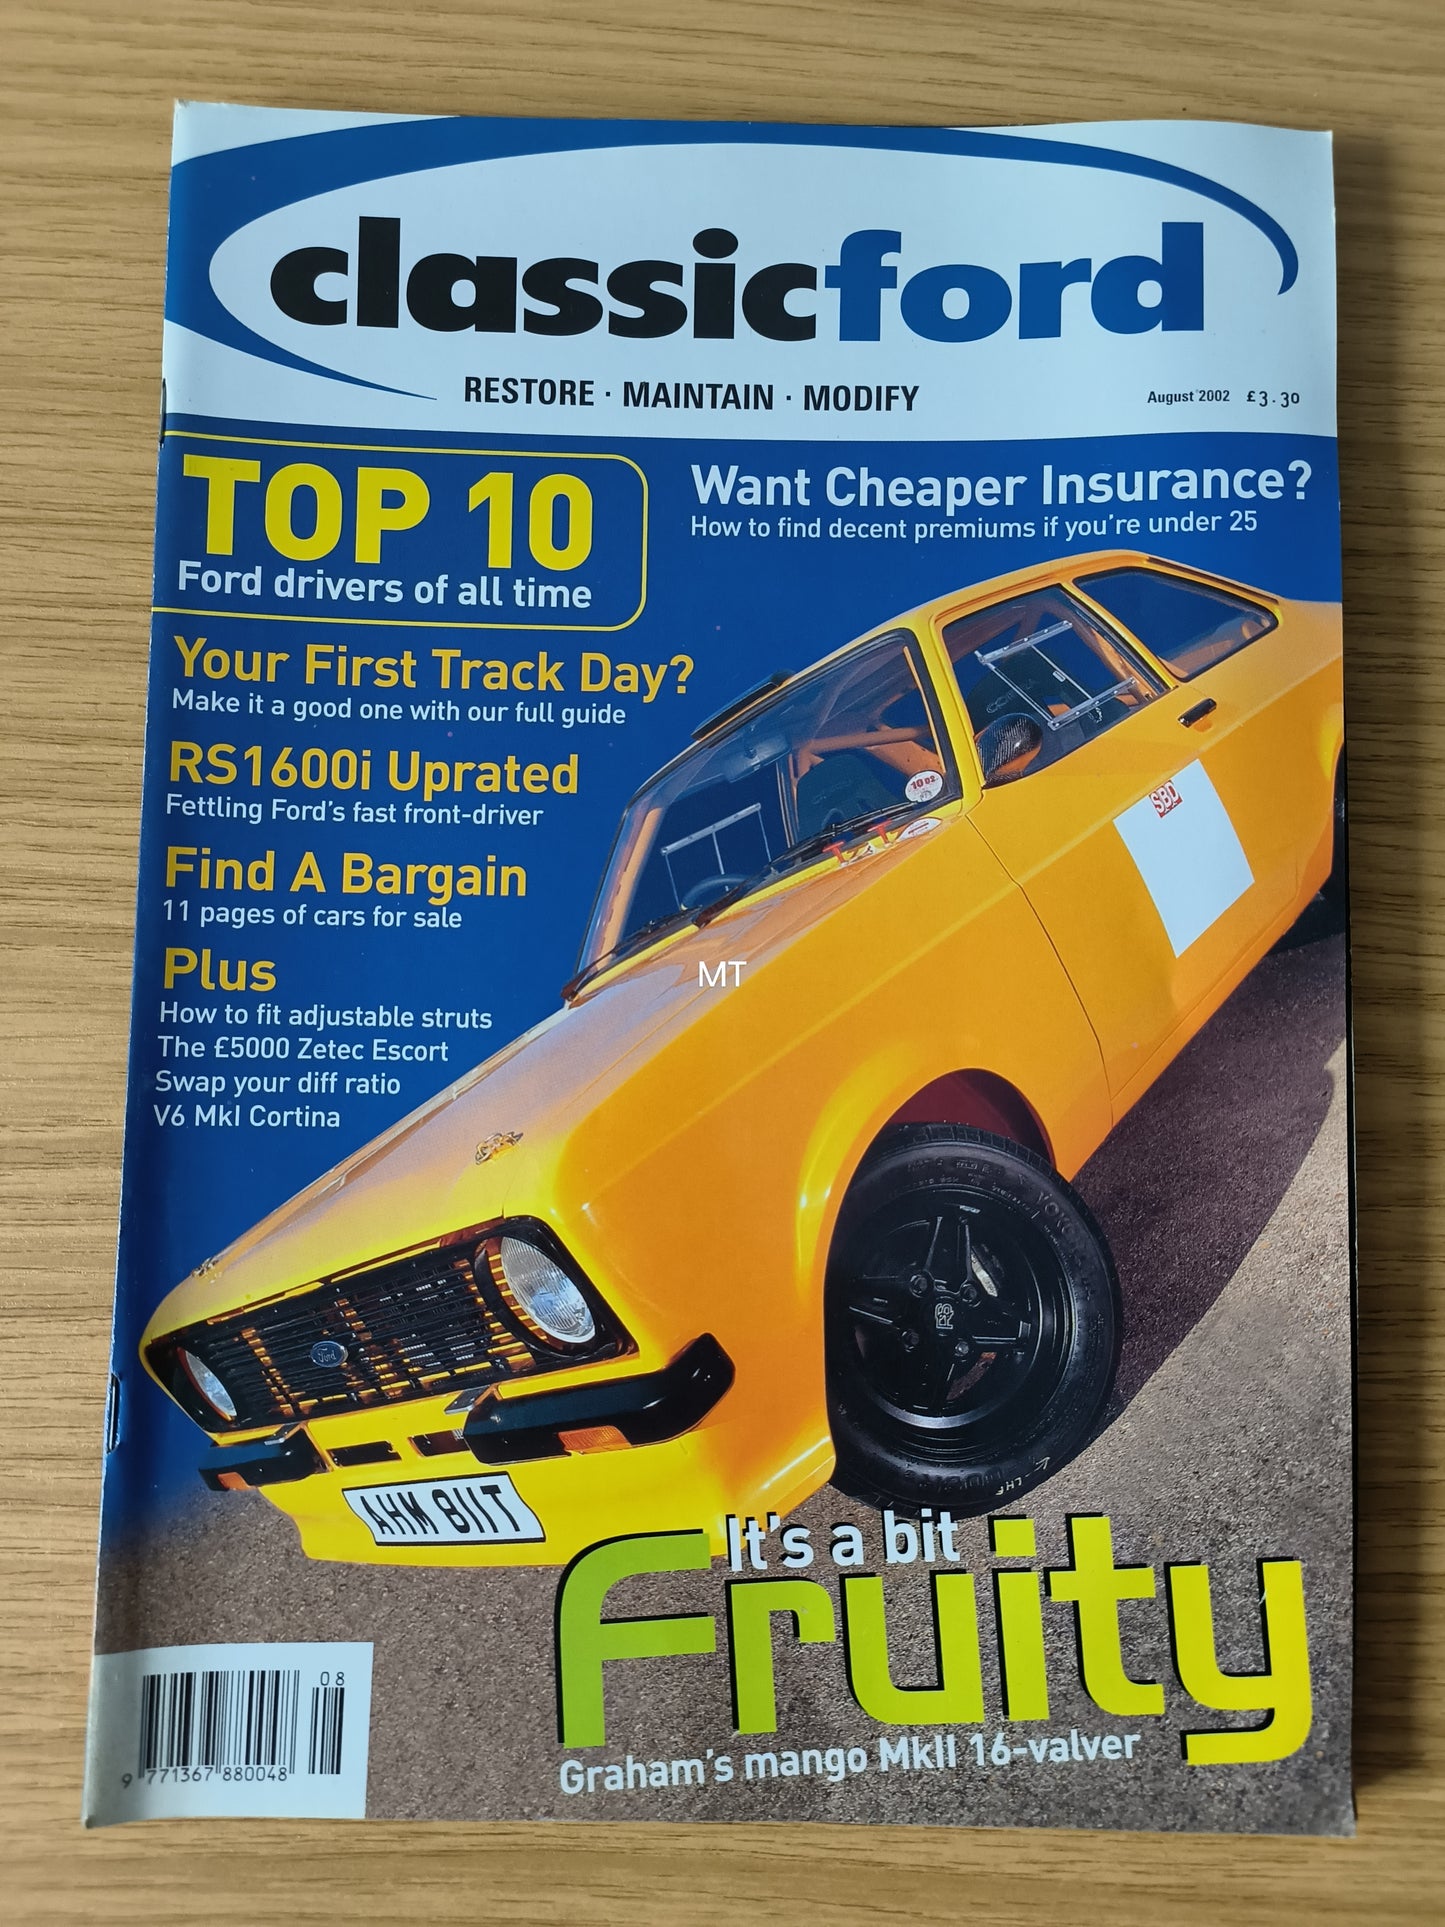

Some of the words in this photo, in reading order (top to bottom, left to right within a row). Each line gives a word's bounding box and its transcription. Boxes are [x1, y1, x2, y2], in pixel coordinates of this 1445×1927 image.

[464, 376, 595, 407] RESTORE
[623, 381, 774, 410] MAINTAIN
[803, 384, 920, 412] MODIFY
[1147, 390, 1194, 406] August
[1198, 389, 1230, 402] 2002
[691, 464, 811, 506] Want
[826, 466, 1028, 517] Cheaper
[1043, 460, 1312, 505] Insurance?
[182, 454, 430, 565] TOP
[468, 472, 593, 571] 10
[691, 515, 742, 537] How
[748, 518, 770, 537] to
[777, 517, 821, 538] find
[829, 517, 907, 538] decent
[915, 517, 1036, 544] premiums
[1044, 516, 1059, 537] if
[1065, 514, 1140, 542] you're
[1149, 510, 1222, 533] under
[1230, 510, 1257, 531] 25
[178, 560, 262, 596] Ford
[274, 567, 404, 603] drivers
[414, 574, 449, 604] of
[458, 575, 503, 606] all
[513, 577, 592, 609] time
[174, 635, 289, 682] Your
[305, 643, 416, 688] First
[431, 648, 564, 691] Track
[580, 652, 694, 703] Day?
[173, 688, 240, 713] Make
[249, 692, 264, 714] it
[271, 699, 285, 715] a
[293, 697, 352, 722] good
[359, 703, 403, 720] one
[409, 699, 460, 721] with
[468, 706, 509, 722] our
[515, 701, 555, 723] full
[561, 703, 626, 728] guide
[170, 741, 371, 790] RS1600i
[388, 750, 579, 802] Uprated
[166, 793, 262, 825] Fettling
[272, 798, 346, 822] Ford's
[353, 801, 397, 823] fast
[404, 802, 544, 825] front-driver
[166, 846, 275, 891] Find
[289, 851, 326, 893] A
[342, 852, 527, 906] Bargain
[163, 899, 188, 921] 11
[200, 906, 275, 929] pages
[283, 903, 307, 925] of
[313, 909, 365, 926] cars
[372, 905, 407, 927] for
[413, 906, 462, 928] sale
[164, 948, 276, 992] Plus
[160, 1001, 217, 1024] How
[224, 1004, 248, 1024] to
[256, 1003, 282, 1025] fit
[288, 1004, 414, 1032] adjustable
[421, 1008, 492, 1029] struts
[157, 1035, 205, 1058] The
[214, 1036, 290, 1059] £5000
[297, 1037, 364, 1060] Zetec
[373, 1038, 449, 1062] Escort
[155, 1070, 226, 1097] Swap
[233, 1076, 291, 1098] your
[298, 1071, 338, 1093] diff
[345, 1072, 401, 1095] ratio
[153, 1104, 185, 1126] V6
[249, 1104, 340, 1128] Cortina
[359, 1489, 440, 1536] AHM
[728, 1515, 814, 1573] It's
[832, 1525, 864, 1567] a
[883, 1508, 961, 1564] bit
[559, 1511, 1315, 1767] Fruity
[222, 1765, 288, 1782] 880048
[559, 1750, 734, 1795] Graham's
[744, 1747, 868, 1783] mango
[969, 1728, 1142, 1766] 16-valver
